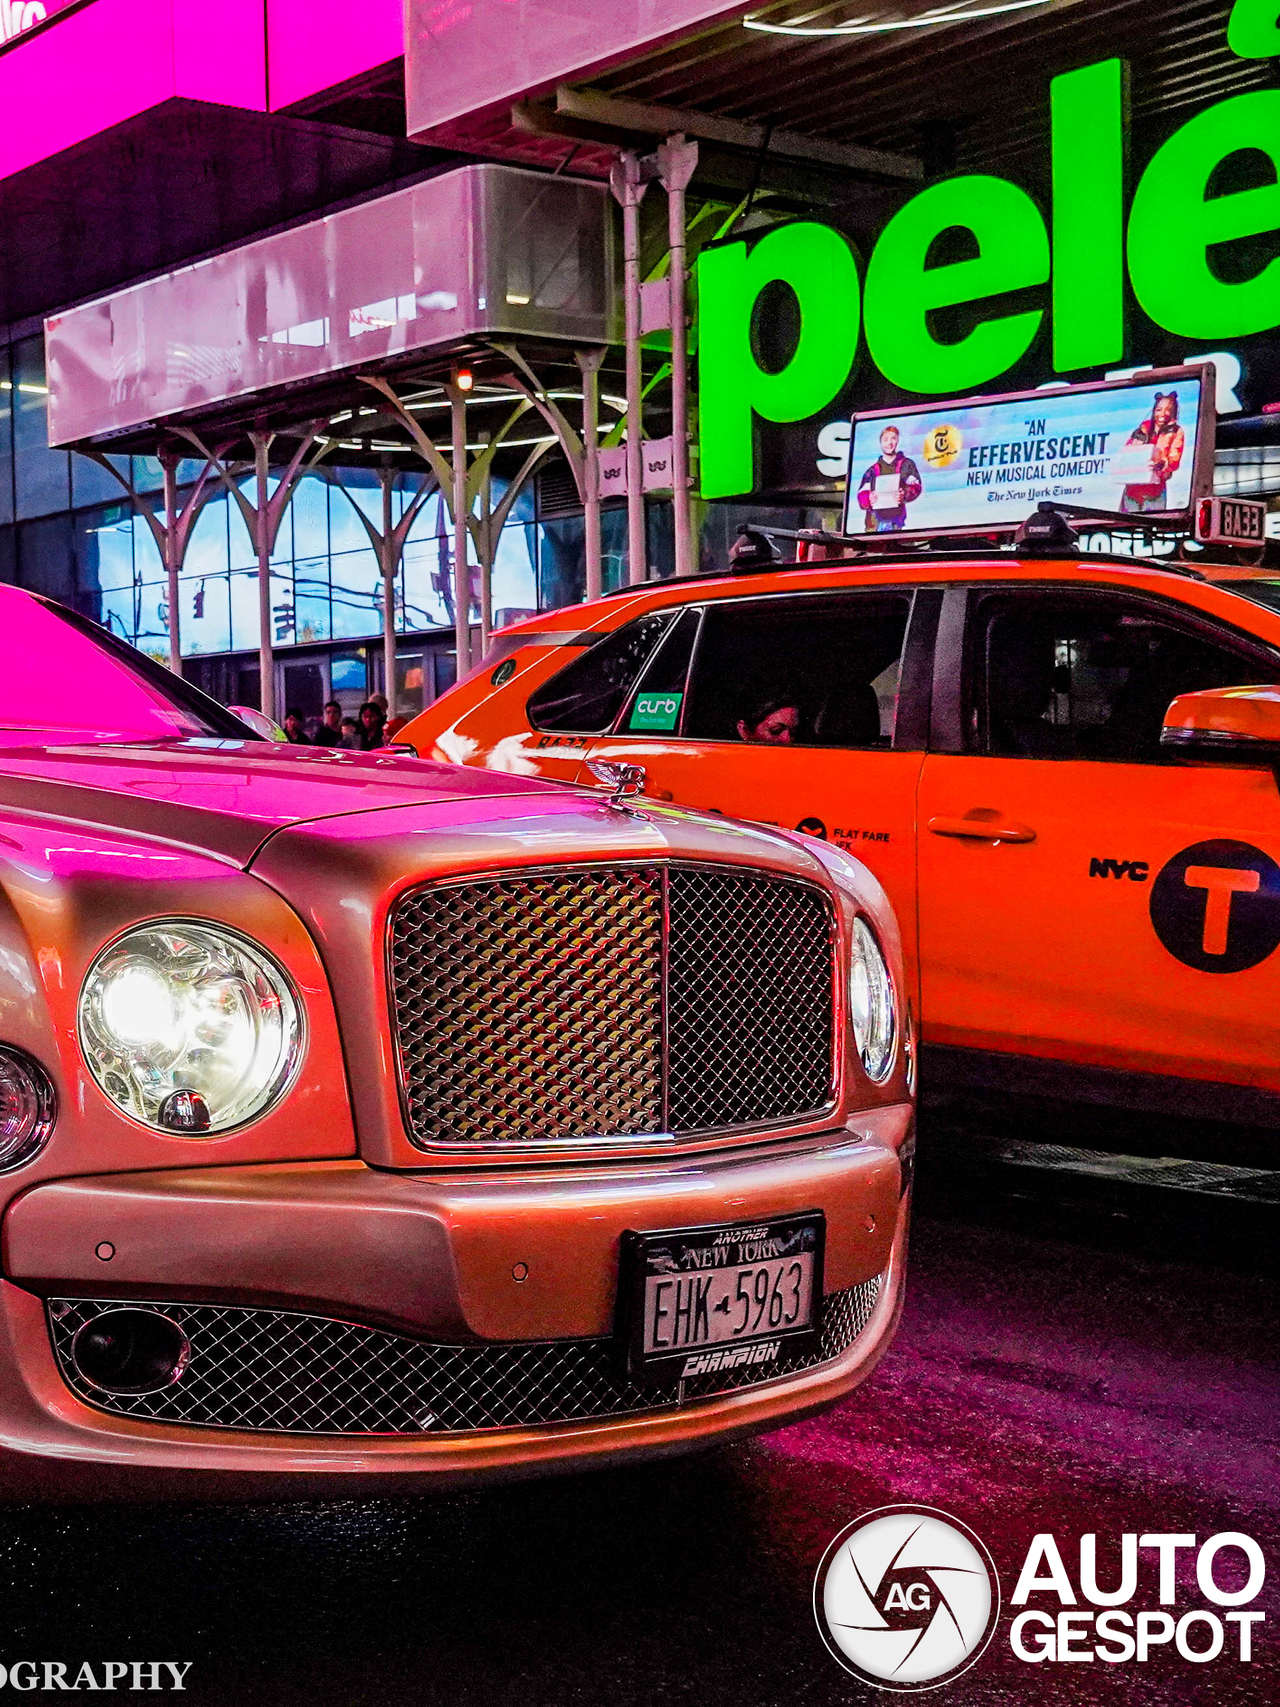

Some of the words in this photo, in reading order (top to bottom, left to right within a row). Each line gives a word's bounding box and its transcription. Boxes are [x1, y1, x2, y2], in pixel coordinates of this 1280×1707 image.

[968, 432, 1110, 468] EFFERVESCENT
[966, 469, 992, 487] NEW
[995, 463, 1047, 484] MUSICAL
[987, 490, 1005, 503] The
[1006, 489, 1026, 501] New
[1028, 486, 1051, 501] York
[1053, 485, 1083, 497] Times
[1223, 505, 1260, 538] 8A33
[637, 698, 676, 714] curb
[834, 828, 860, 840] FLAT
[862, 831, 891, 843] FARE
[1089, 857, 1150, 882] NYC
[684, 1245, 732, 1271] NEW
[737, 1238, 780, 1263] YORK
[680, 1341, 782, 1378] CHAMPION
